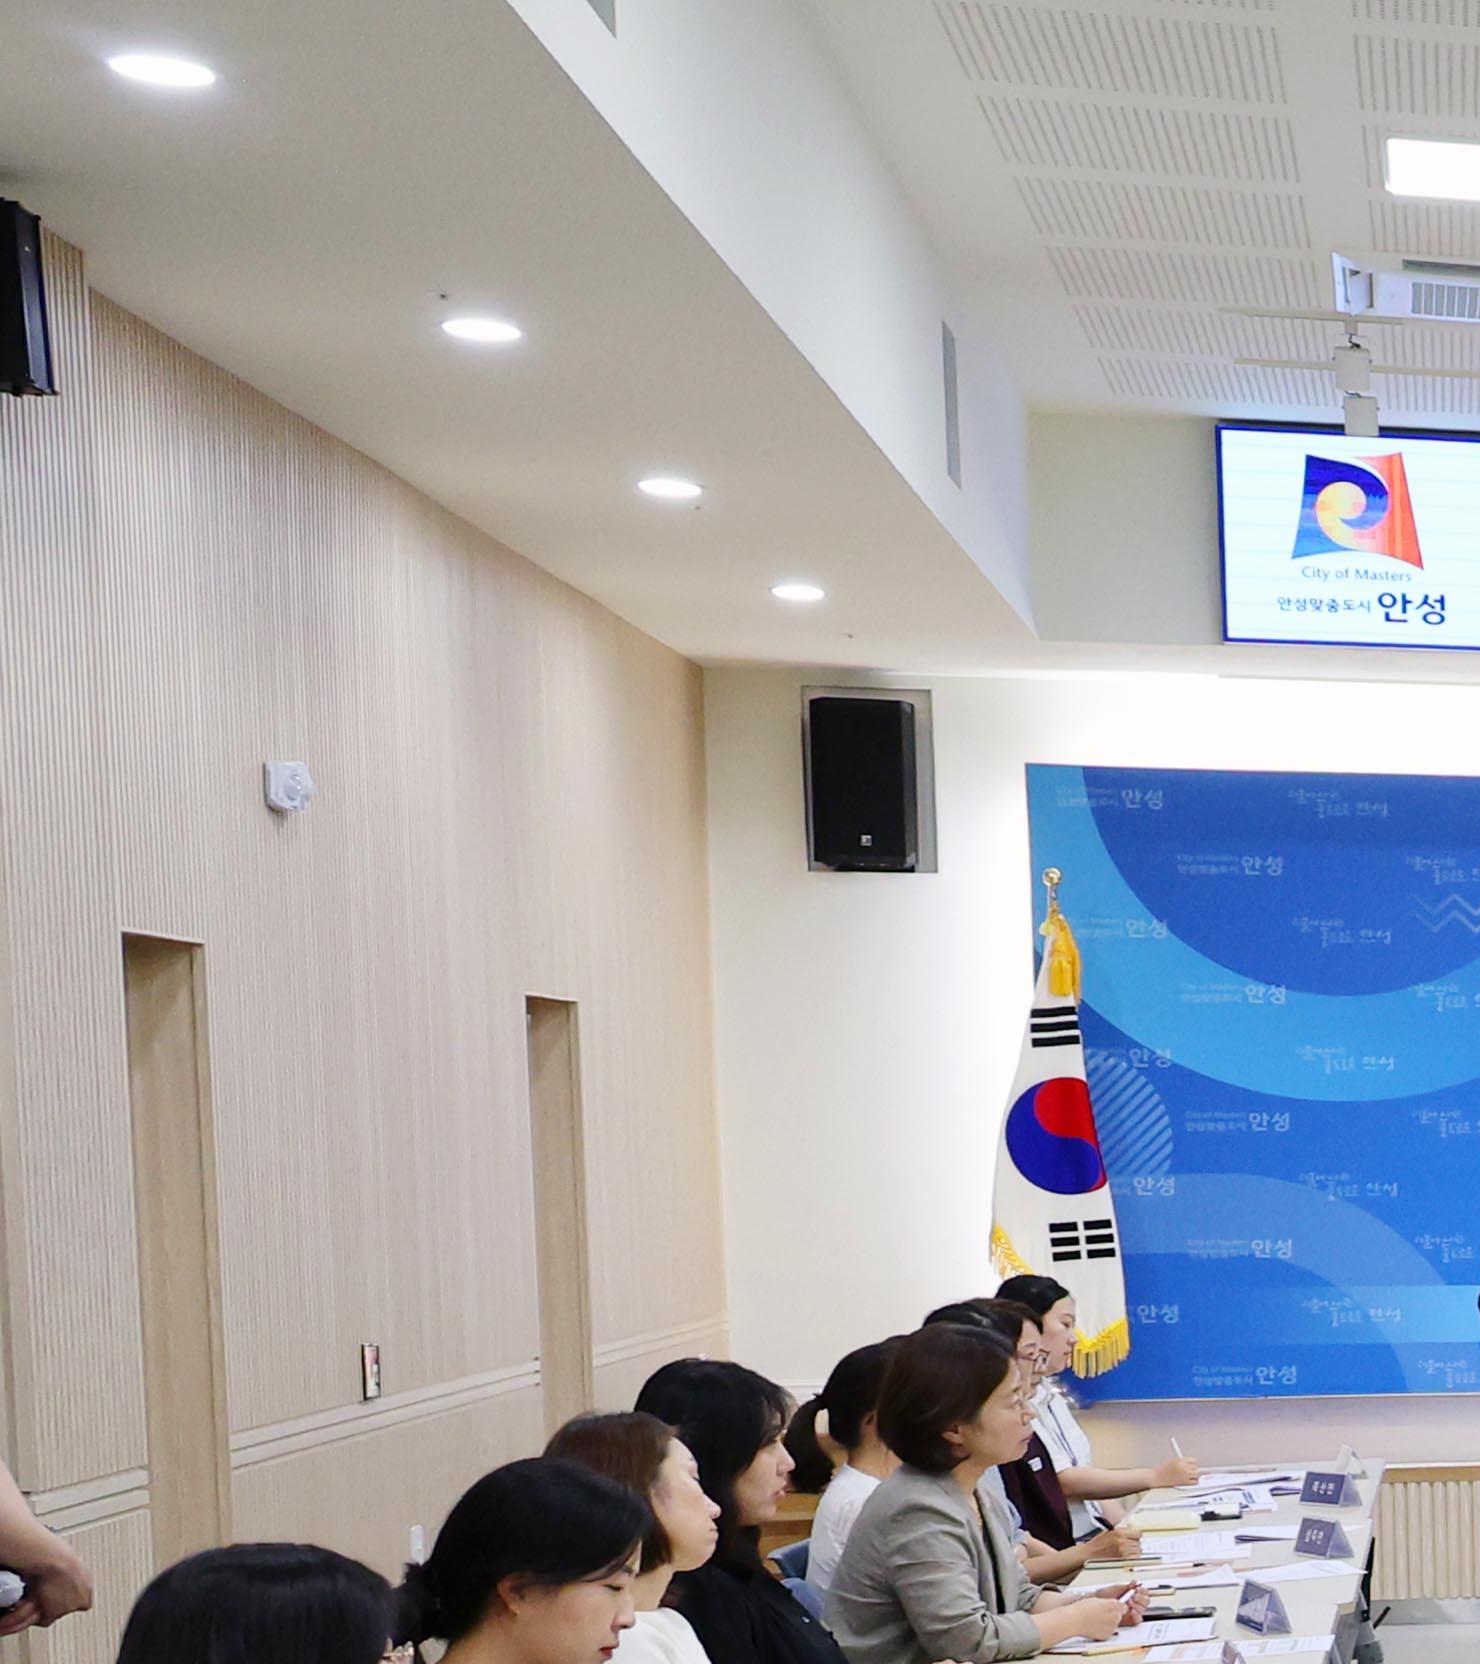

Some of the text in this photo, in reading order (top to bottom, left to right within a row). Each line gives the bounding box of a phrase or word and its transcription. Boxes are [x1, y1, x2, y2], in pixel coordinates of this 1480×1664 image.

[1301, 566, 1412, 583] City of Masters
[1277, 592, 1446, 626] 안성맞춤도시 안성
[1120, 788, 1164, 810] 안성
[1240, 854, 1283, 876] 안성
[1124, 918, 1168, 940] 안성
[1243, 983, 1286, 1005] 안성
[1128, 1047, 1172, 1068] 안성
[1247, 1111, 1290, 1132] 안성
[1132, 1175, 1176, 1197] 안성
[1250, 1238, 1293, 1259] 안성
[1136, 1303, 1180, 1325] 안성
[1255, 1364, 1297, 1385] 안성
